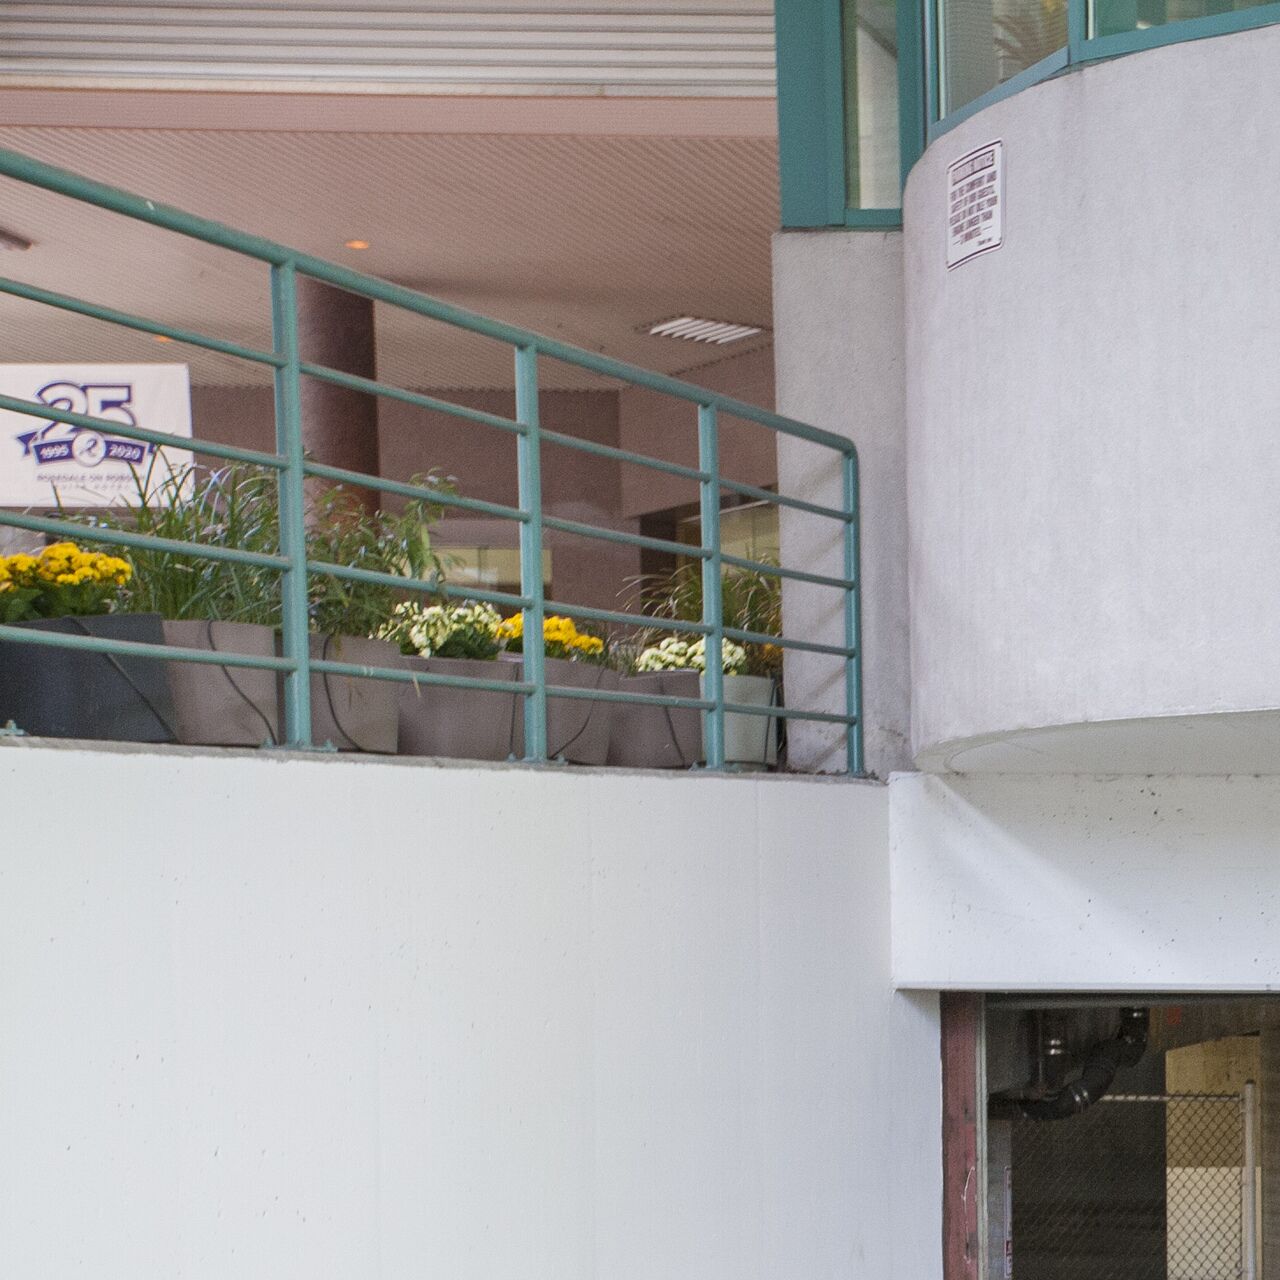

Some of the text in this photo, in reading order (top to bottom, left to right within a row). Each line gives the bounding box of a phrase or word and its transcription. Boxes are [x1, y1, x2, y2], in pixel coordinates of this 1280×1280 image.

[36, 380, 137, 441] 25
[40, 444, 70, 460] 1995
[109, 445, 140, 461] 2020
